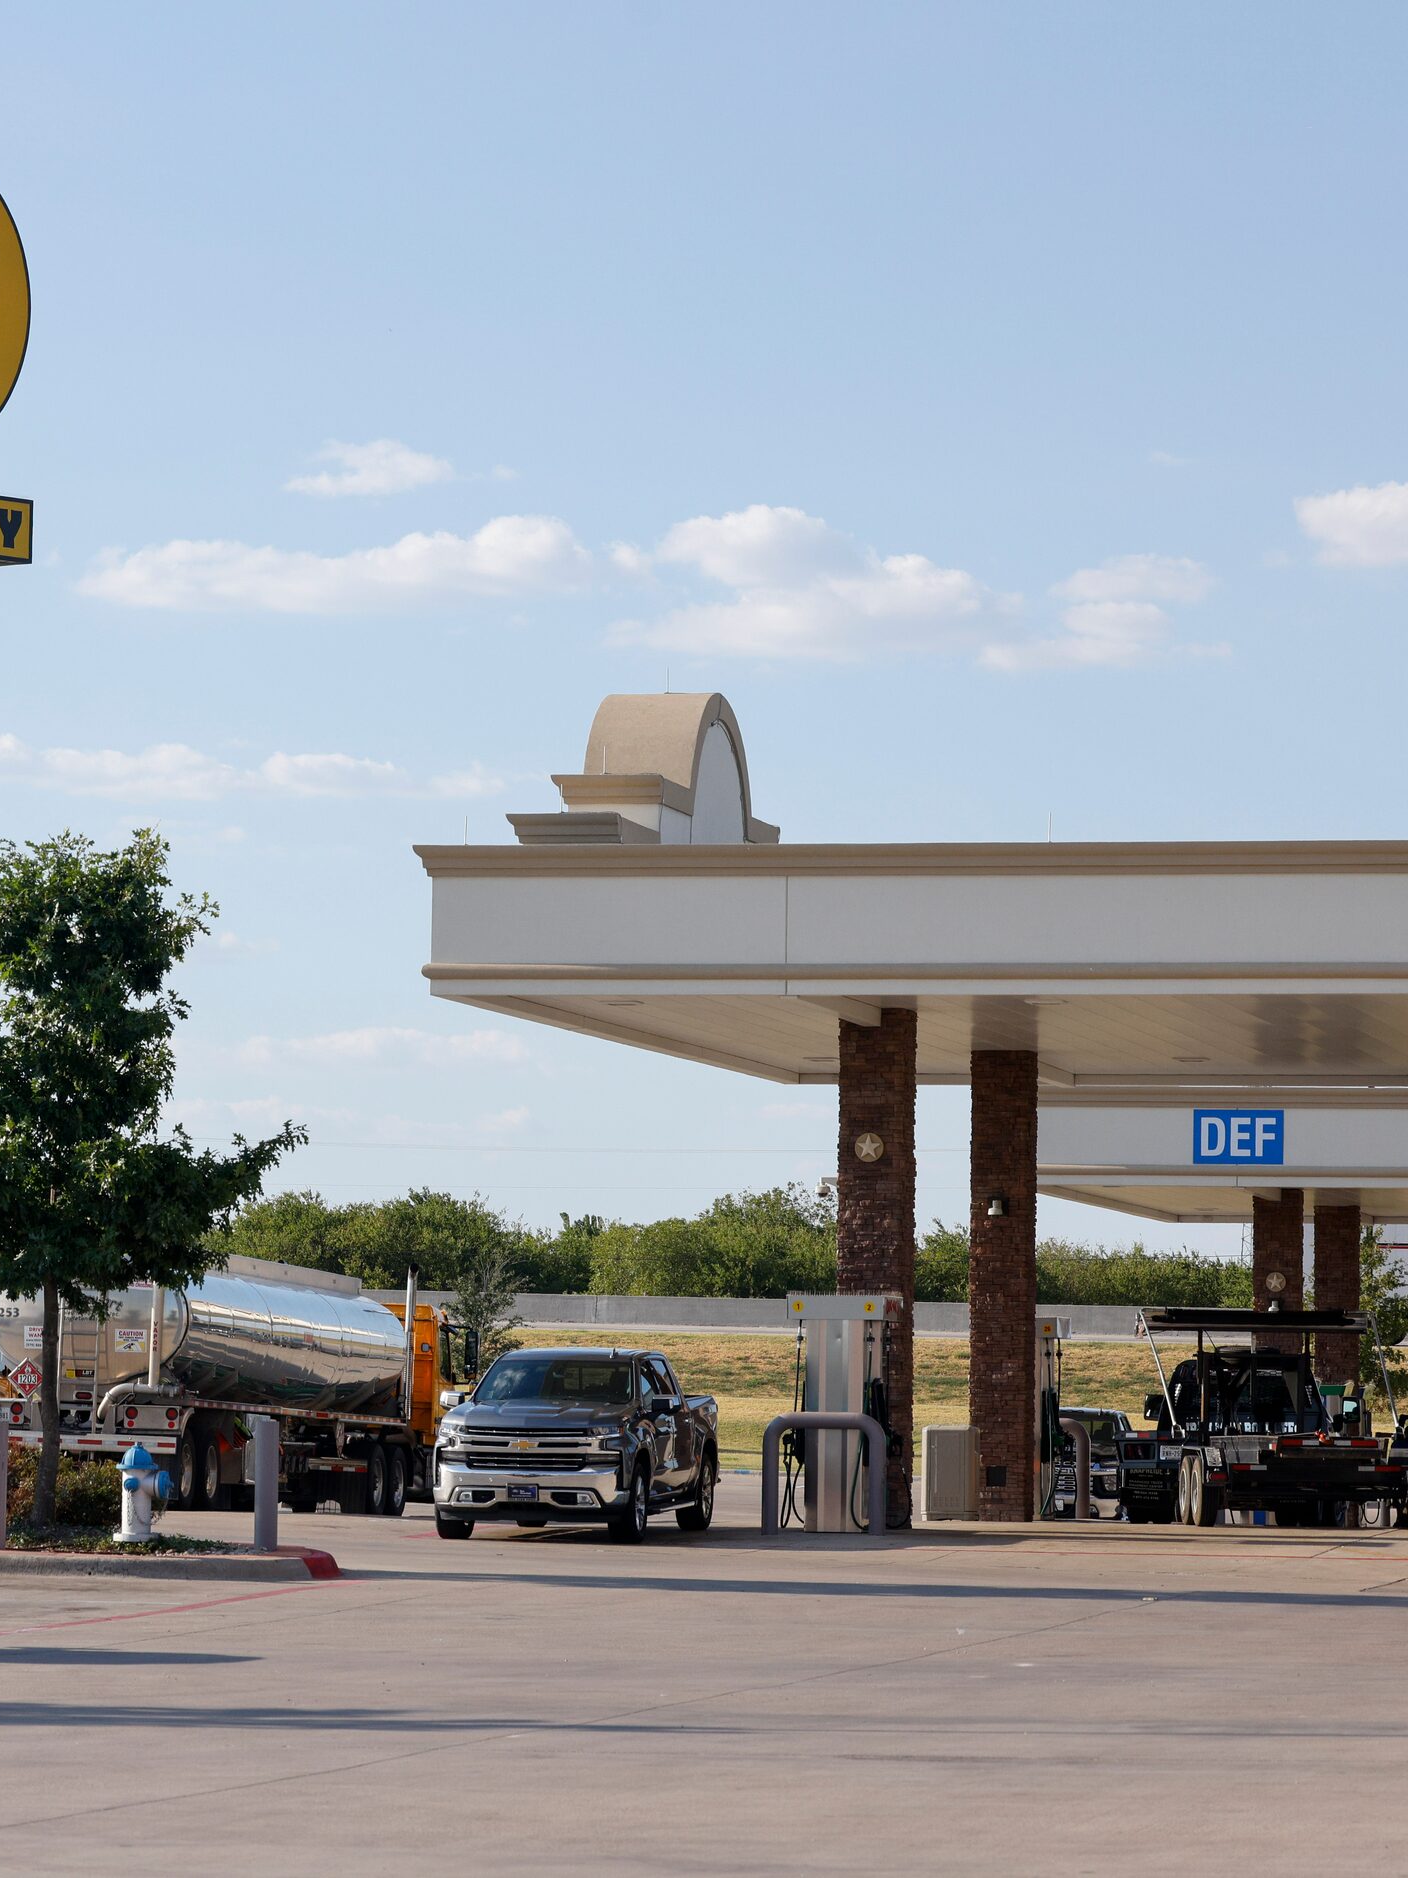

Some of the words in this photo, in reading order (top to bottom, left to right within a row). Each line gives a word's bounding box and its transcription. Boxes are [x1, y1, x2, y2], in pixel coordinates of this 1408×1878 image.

[1200, 1116, 1277, 1157] DEF
[867, 1303, 872, 1311] 2
[19, 1374, 37, 1384] 1203
